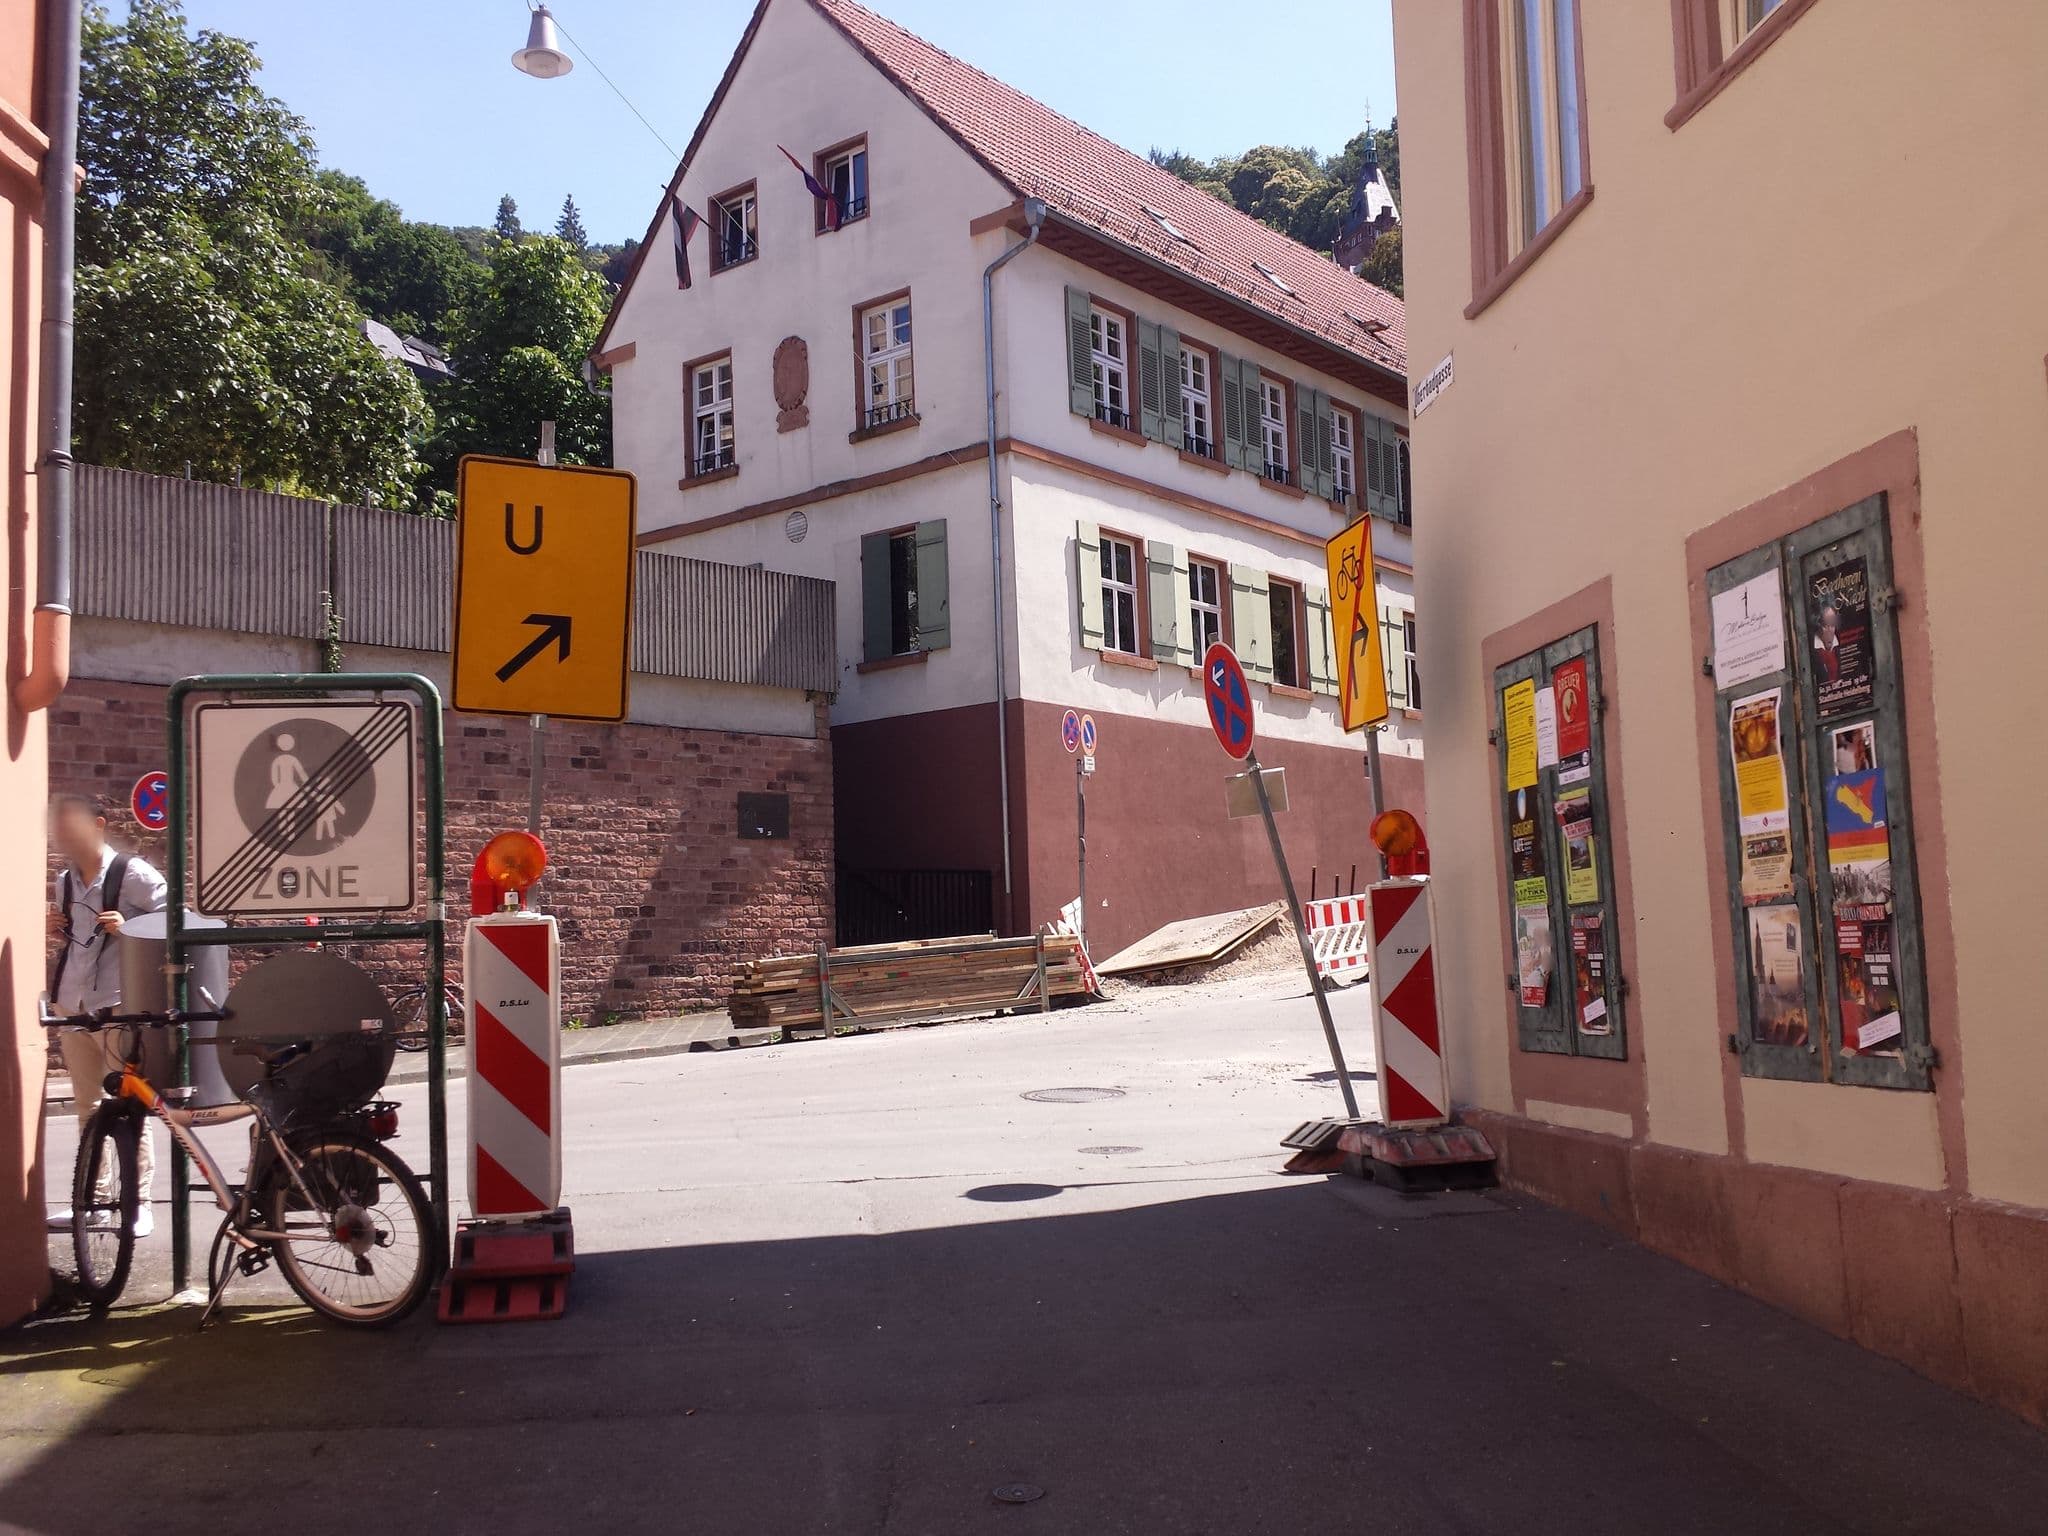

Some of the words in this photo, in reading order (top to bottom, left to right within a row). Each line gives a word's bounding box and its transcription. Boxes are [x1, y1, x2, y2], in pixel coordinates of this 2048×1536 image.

[505, 502, 543, 555] U
[252, 865, 360, 900] ZONE
[499, 999, 530, 1008] D.S.Lu
